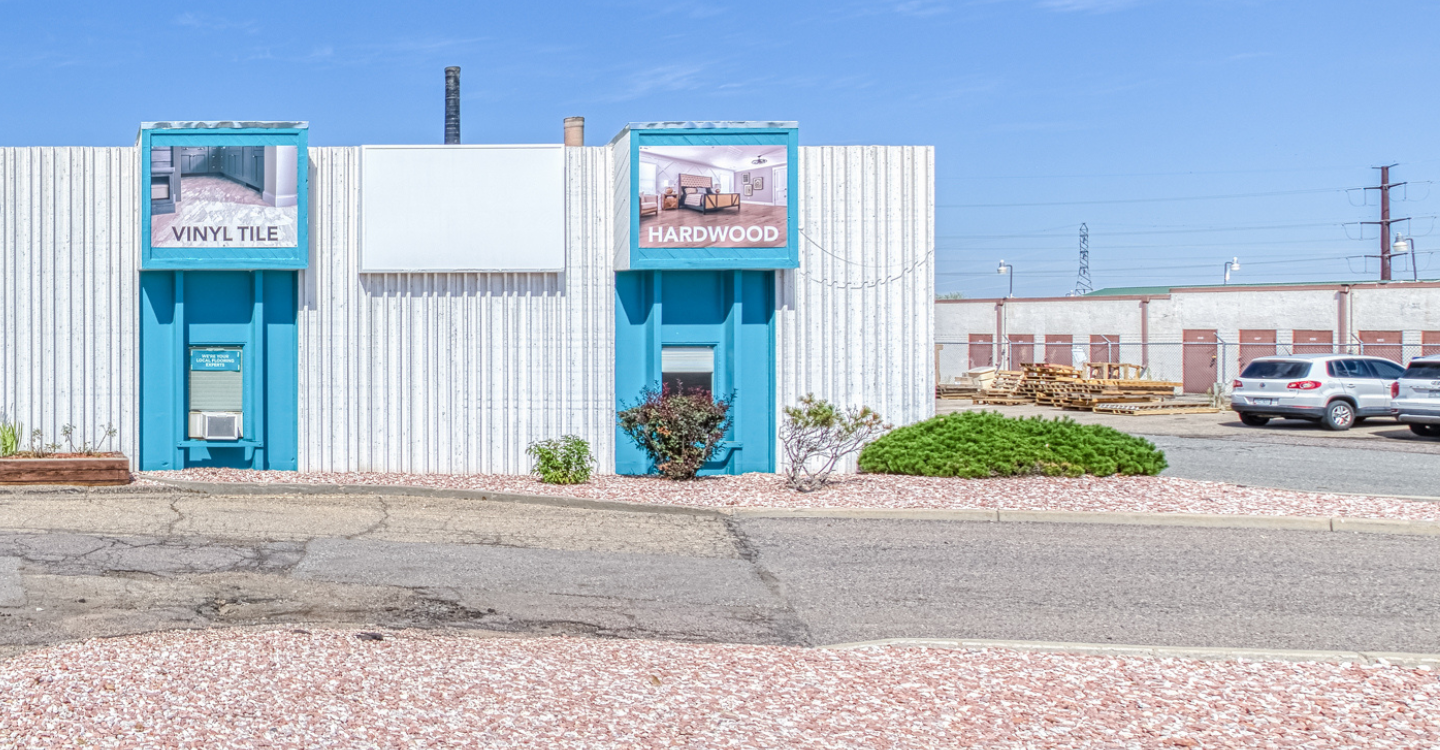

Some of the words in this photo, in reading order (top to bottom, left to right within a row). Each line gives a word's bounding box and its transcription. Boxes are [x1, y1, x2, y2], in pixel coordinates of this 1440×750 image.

[171, 226, 233, 242] VINYL
[237, 226, 278, 242] TILE
[648, 225, 779, 242] HARDWOOD
